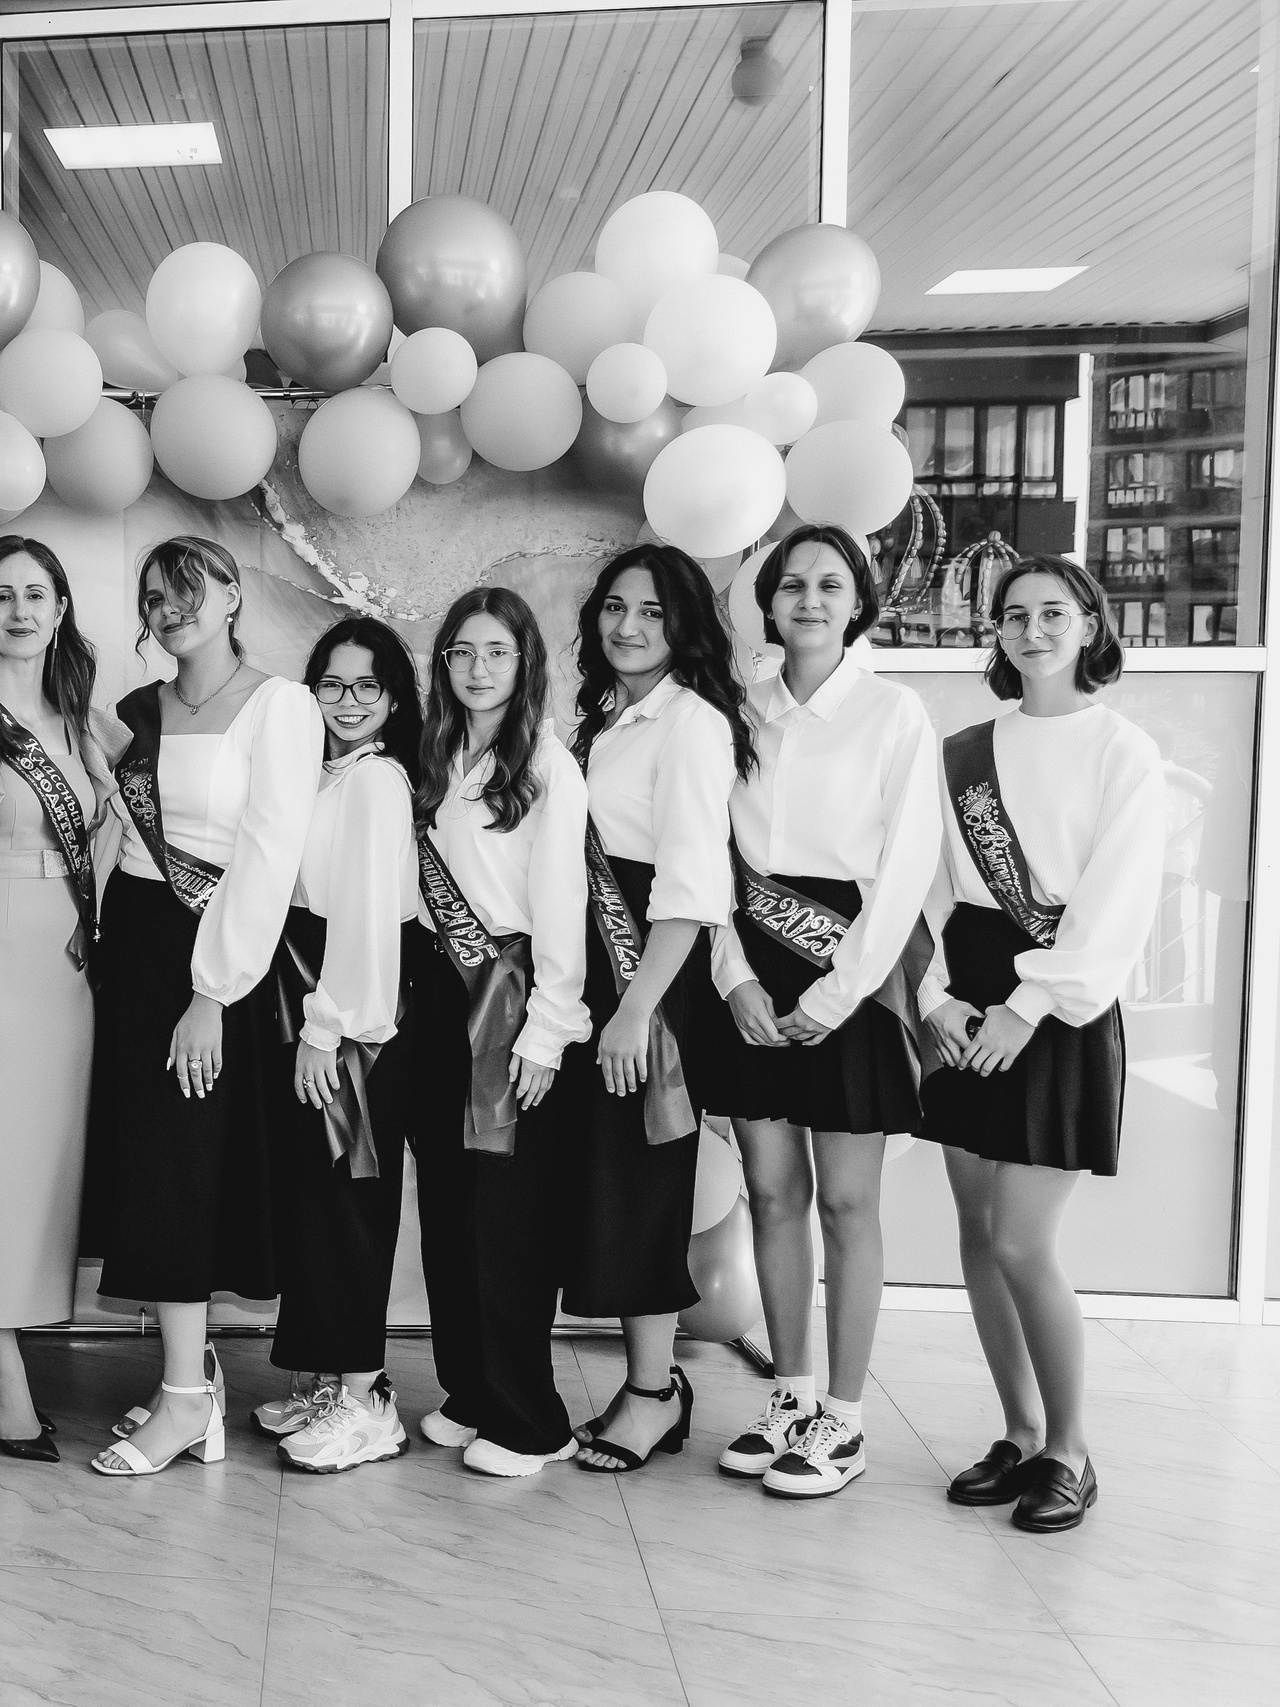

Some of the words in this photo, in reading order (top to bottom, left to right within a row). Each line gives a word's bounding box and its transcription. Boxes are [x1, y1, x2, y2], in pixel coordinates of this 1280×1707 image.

[16, 754, 82, 870] ОВОДИТЕЛЬ
[23, 737, 84, 829] Классный
[434, 901, 500, 968] 2025
[762, 896, 850, 958] 2025
